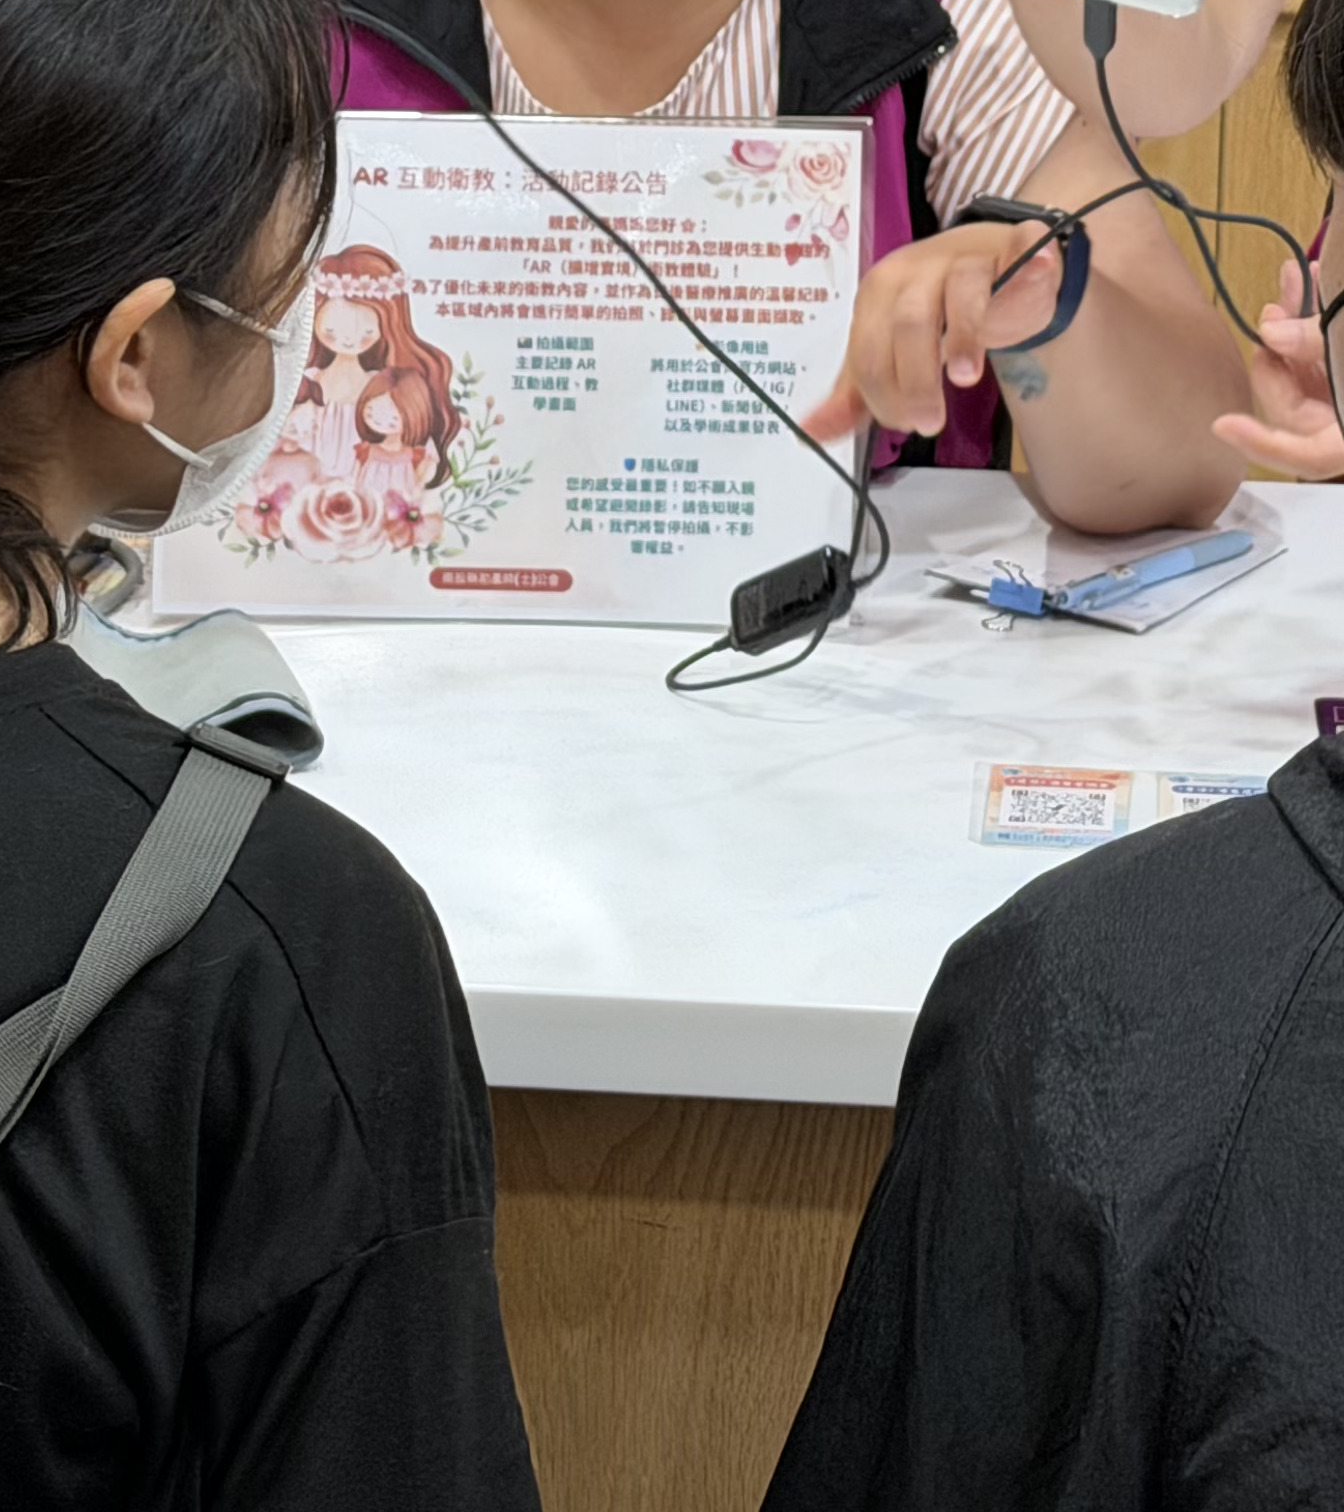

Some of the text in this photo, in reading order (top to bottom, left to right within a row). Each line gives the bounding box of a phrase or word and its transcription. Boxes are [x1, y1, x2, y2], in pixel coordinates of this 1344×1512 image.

[352, 167, 389, 187] AR
[435, 302, 816, 326] 本區域內將會進行簡單的拍照、錄與螢幕畫面擷取。
[576, 358, 596, 371] AR
[650, 357, 807, 376] 將用於公會官方網站、
